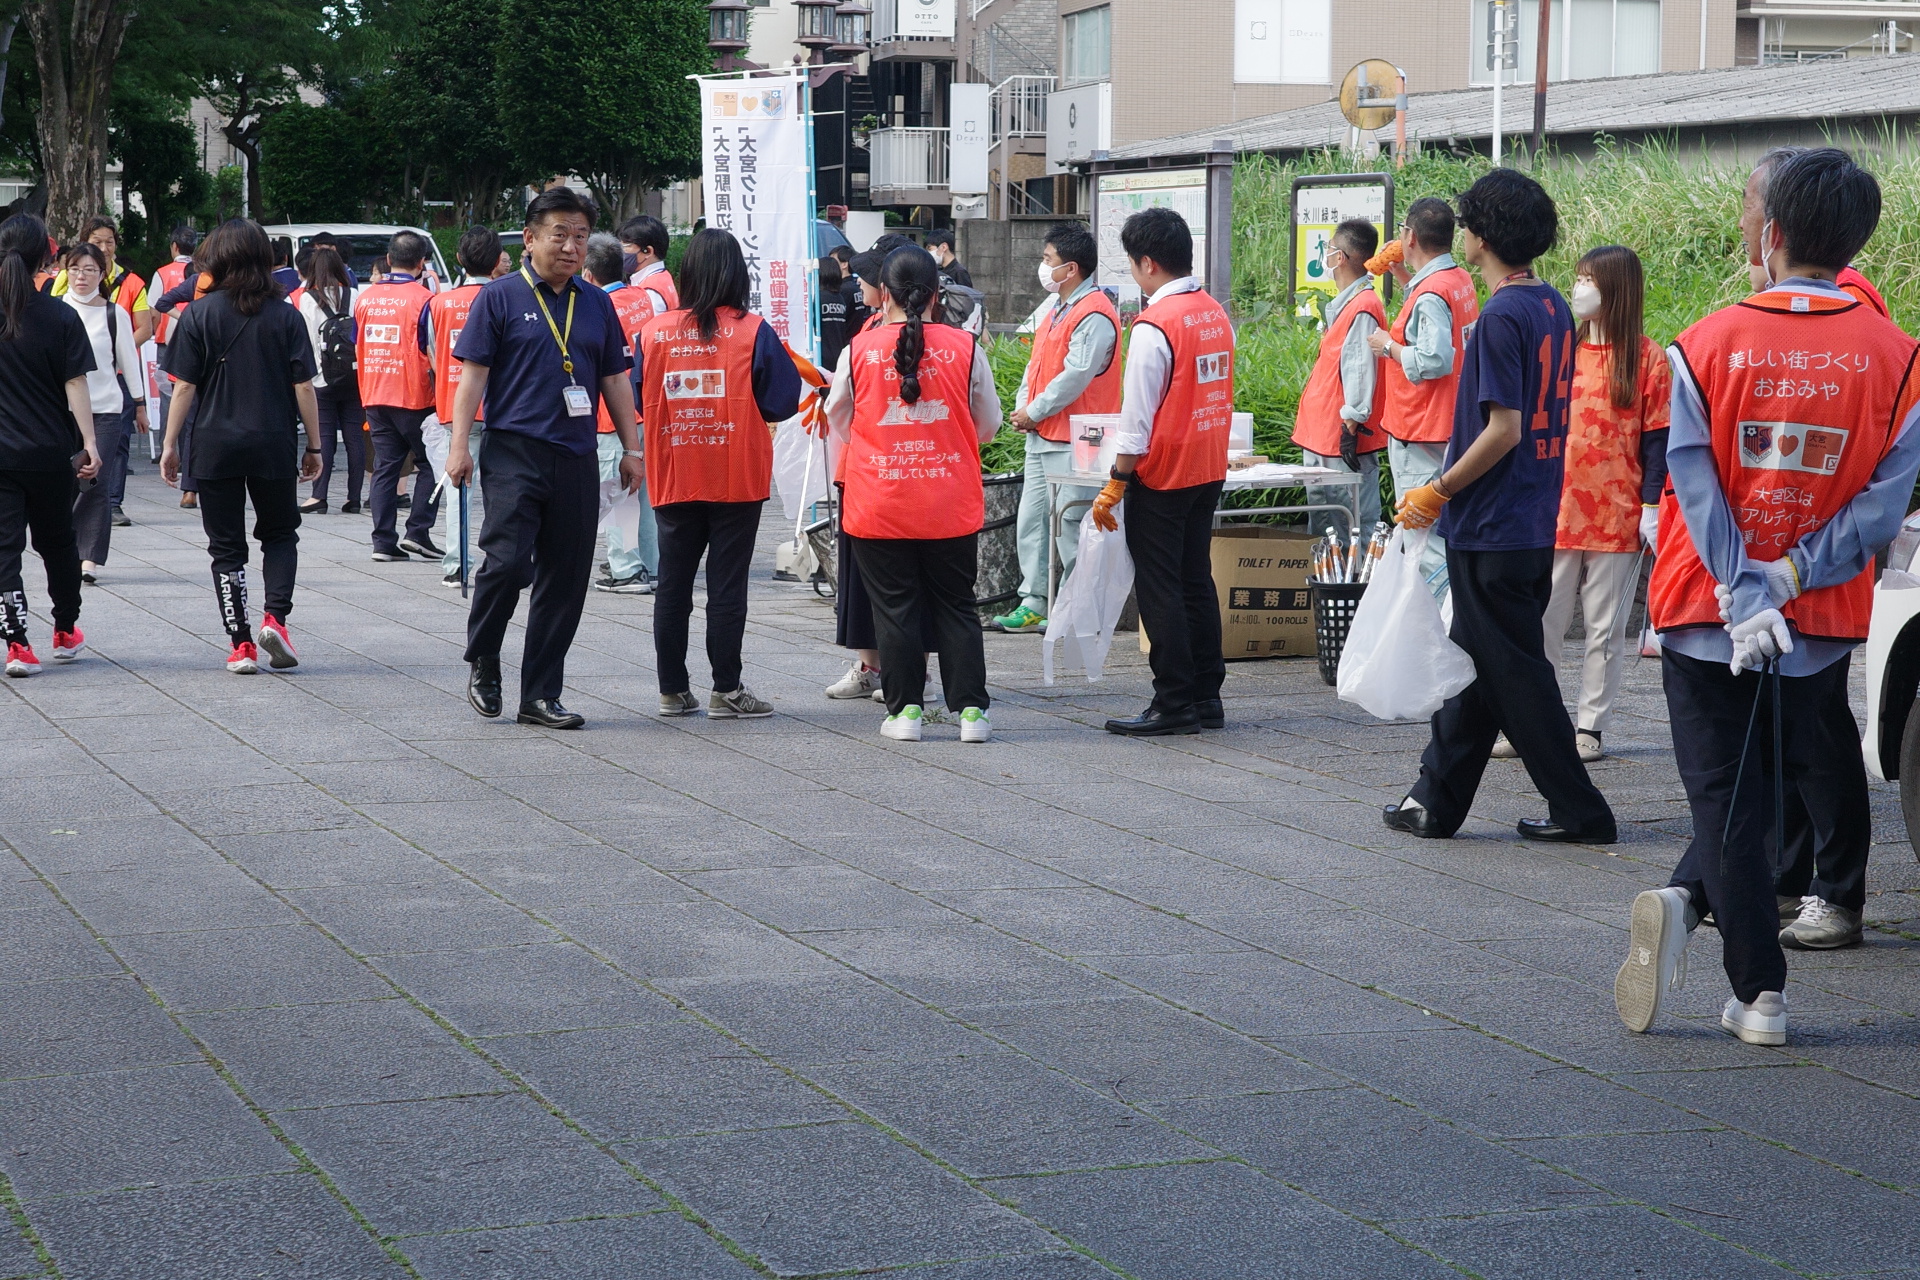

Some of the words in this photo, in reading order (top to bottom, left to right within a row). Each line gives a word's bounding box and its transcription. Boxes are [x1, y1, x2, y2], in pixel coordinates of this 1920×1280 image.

[670, 344, 718, 358] おおみや
[1726, 348, 1870, 375] 美しい街づくり
[1531, 329, 1572, 431] 14
[1752, 377, 1841, 401] おおみや
[675, 407, 715, 419] 大宮区は
[892, 440, 936, 453] 大宮区は
[869, 452, 962, 468] 大宮アルディージャを
[877, 467, 952, 480] 応援しています。
[1753, 486, 1815, 507] 大宮区は
[1237, 557, 1273, 569] TOILET
[1278, 558, 1309, 569] PAPER
[1233, 589, 1309, 607] 業務用
